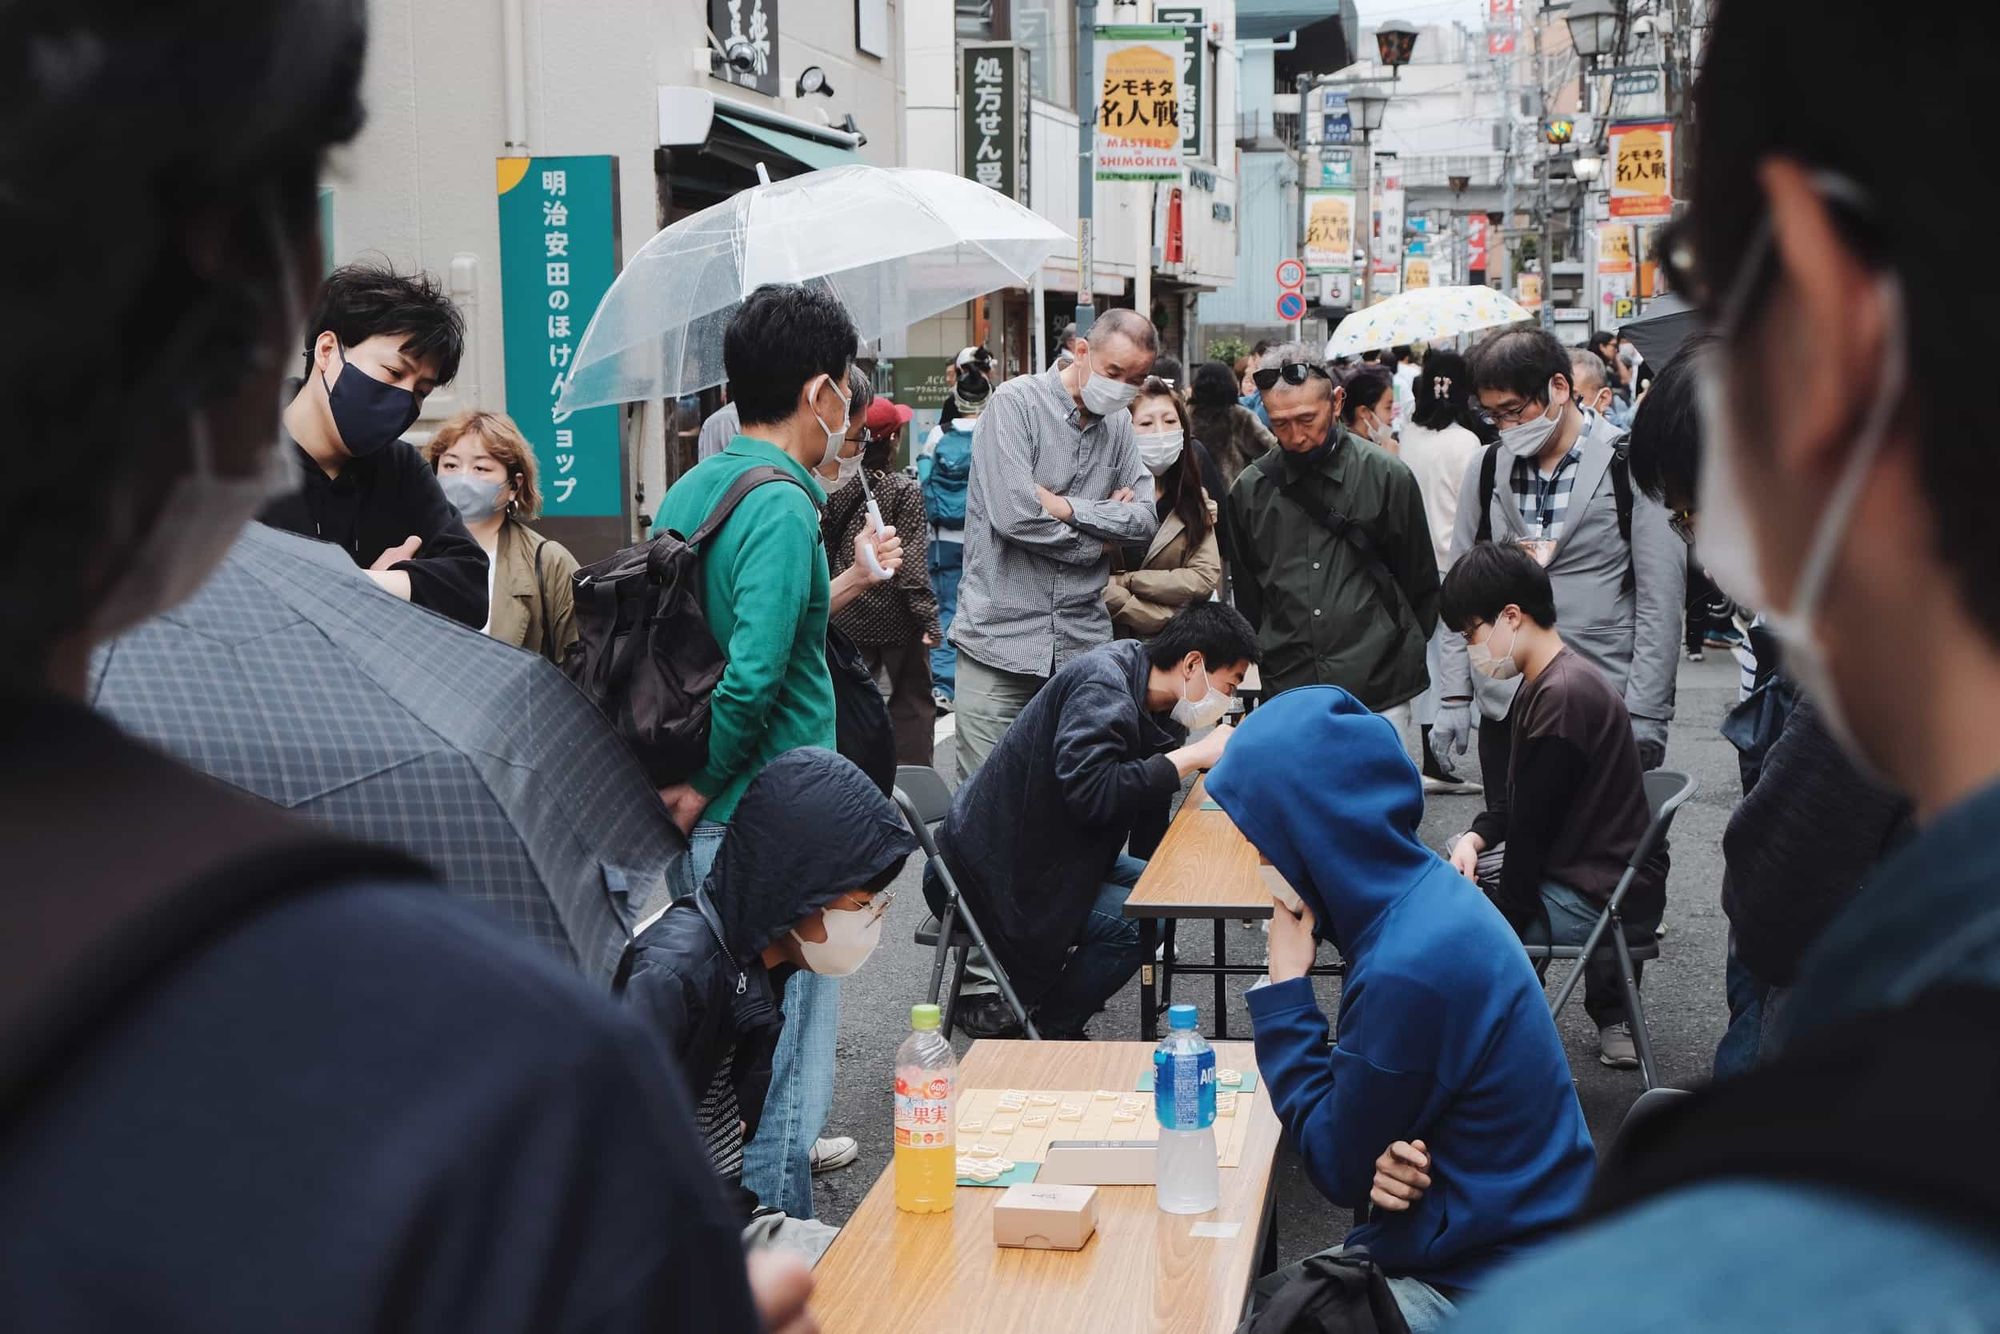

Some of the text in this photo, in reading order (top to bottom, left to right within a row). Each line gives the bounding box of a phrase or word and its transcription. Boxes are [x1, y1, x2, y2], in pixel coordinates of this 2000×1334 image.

[1103, 79, 1174, 97] シモキタ
[1100, 99, 1179, 128] 名人戦
[1106, 138, 1171, 149] MASTERS
[1099, 156, 1178, 167] SHIMOKITA
[1618, 149, 1664, 162] シモキタ
[1617, 162, 1667, 182] 名人戦
[1283, 266, 1299, 281] 30
[1616, 301, 1632, 318] P
